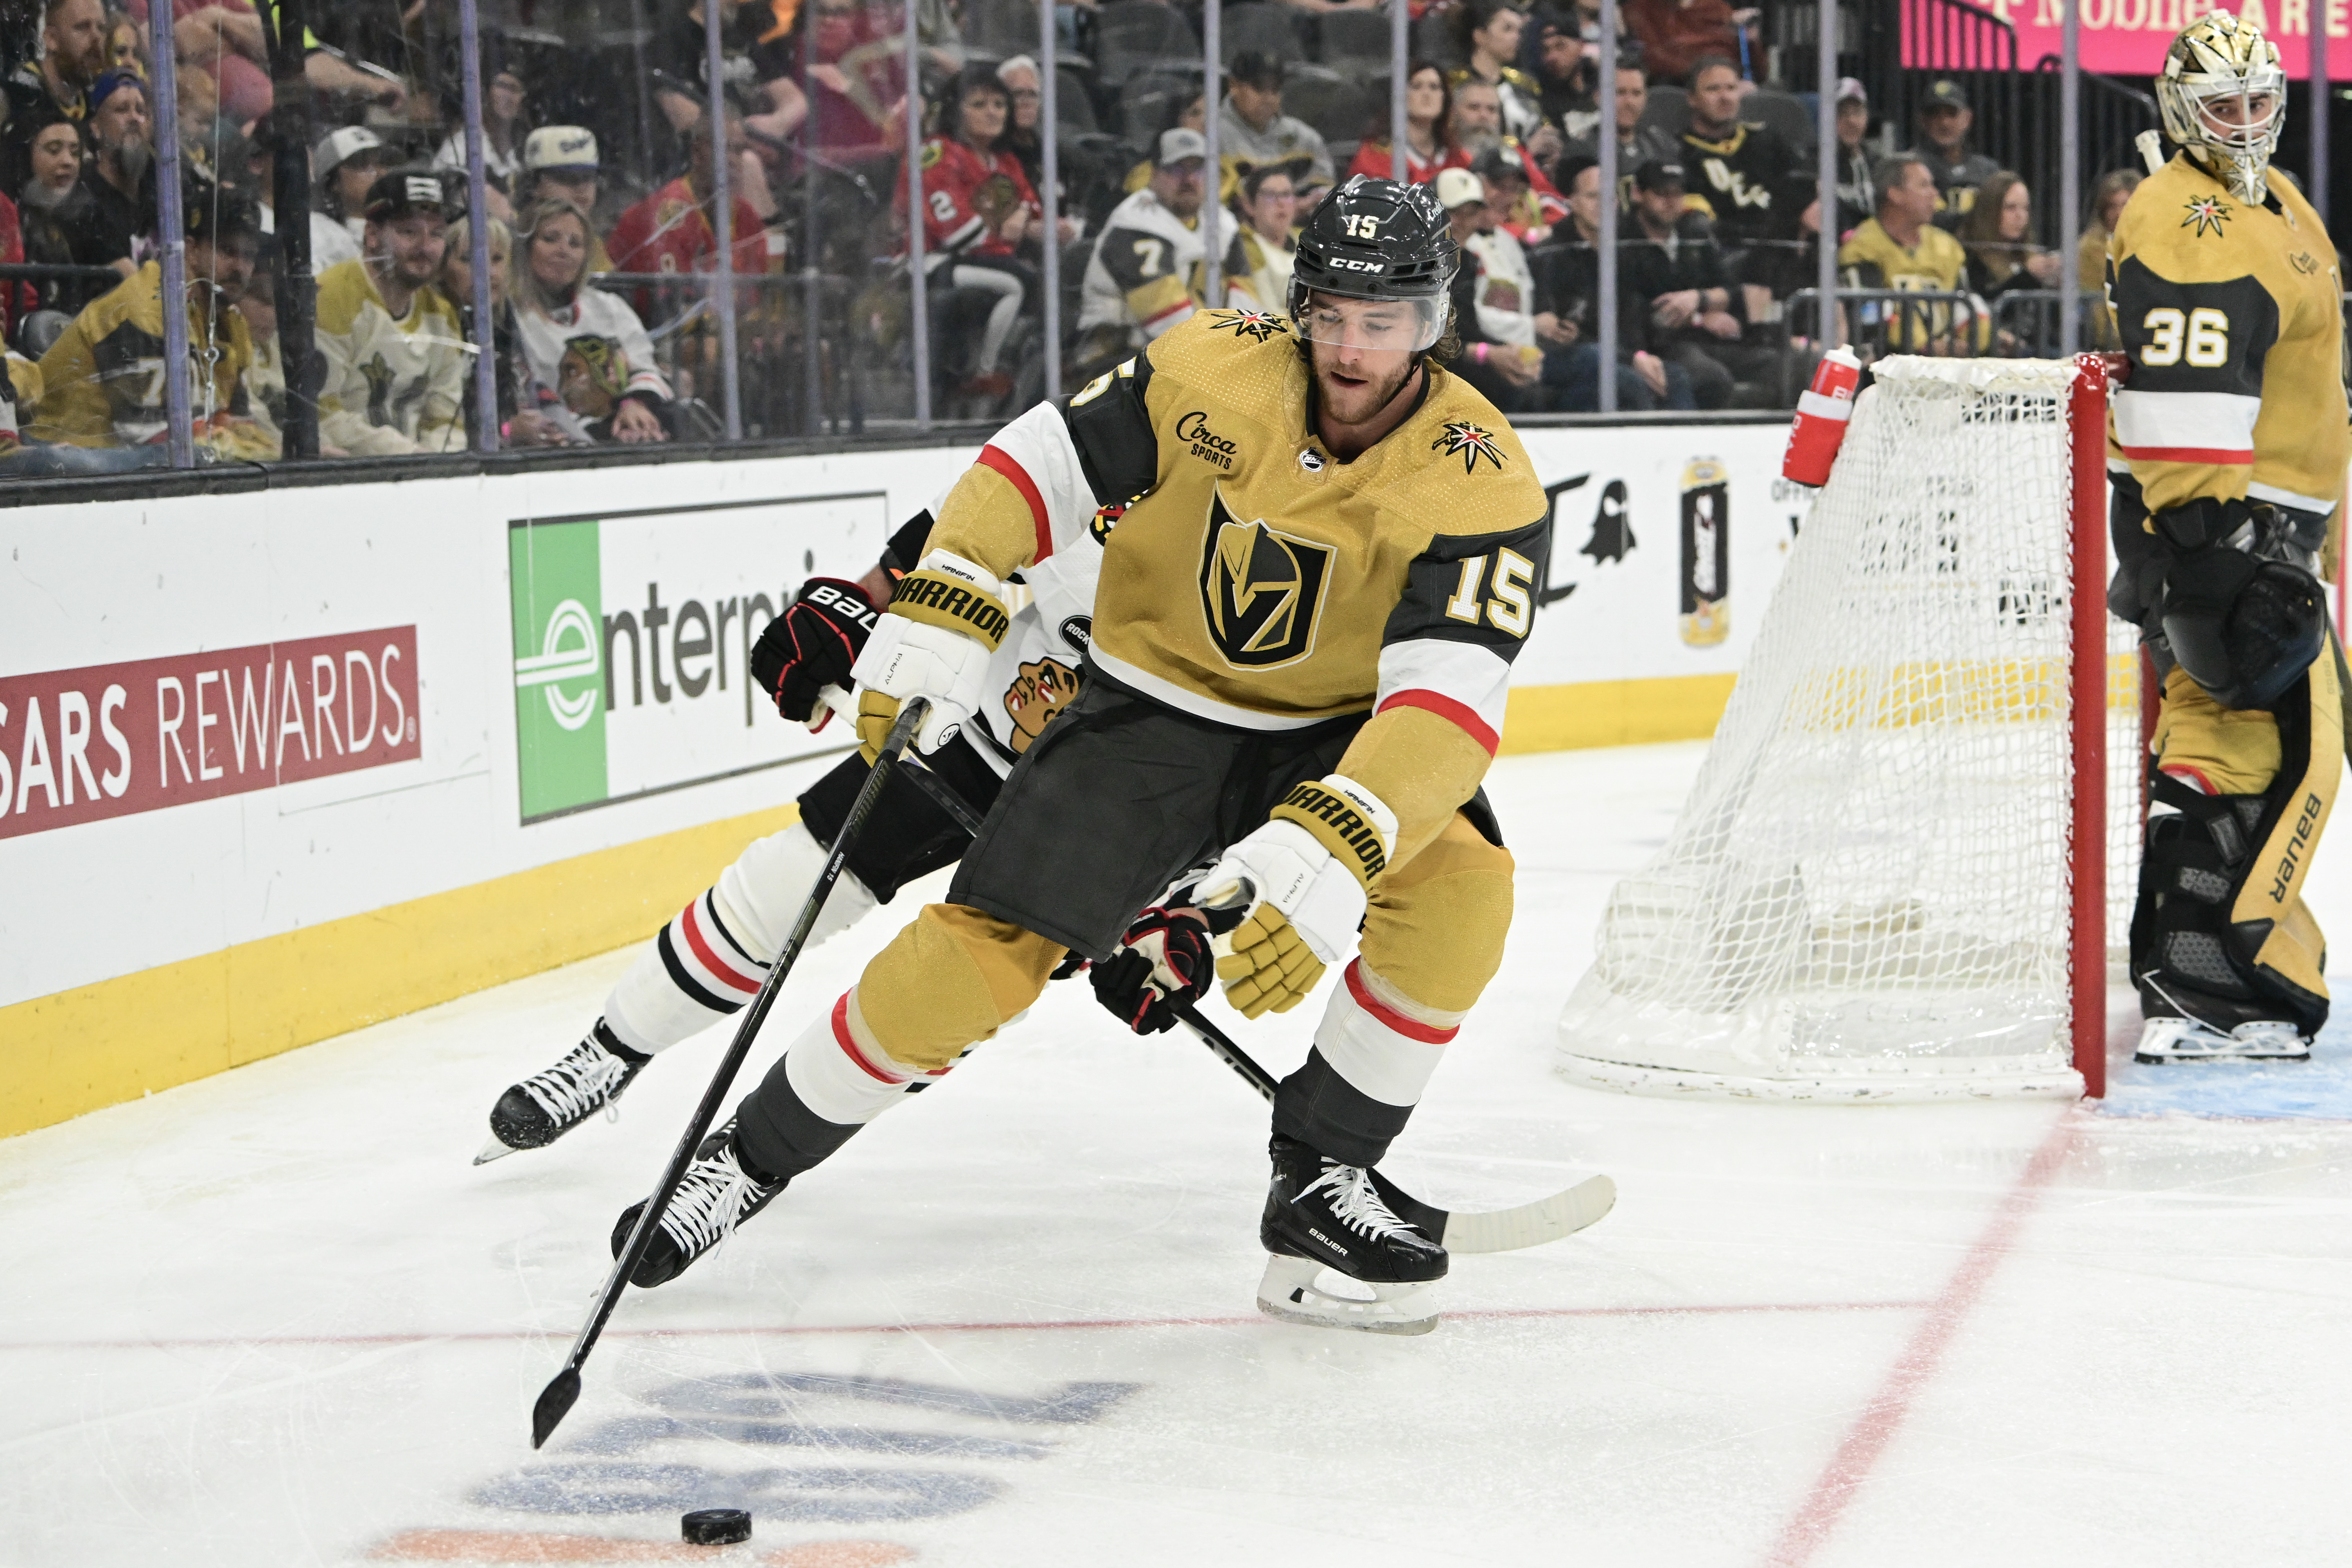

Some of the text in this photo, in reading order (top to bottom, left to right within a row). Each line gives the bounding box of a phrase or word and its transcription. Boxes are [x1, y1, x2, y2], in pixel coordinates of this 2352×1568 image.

[929, 190, 959, 222] 2
[1347, 214, 1379, 239] 15
[1133, 239, 1163, 276] 7
[1329, 257, 1384, 273] CCM
[2140, 307, 2229, 368] 36
[1176, 411, 1237, 454] Circa
[1191, 443, 1232, 470] SPORTS
[942, 564, 976, 581] HANIFIN
[1445, 546, 1535, 639] 15
[885, 653, 903, 685] ALPHA
[1344, 789, 1376, 807] HANIFIN
[826, 873, 835, 882] 15
